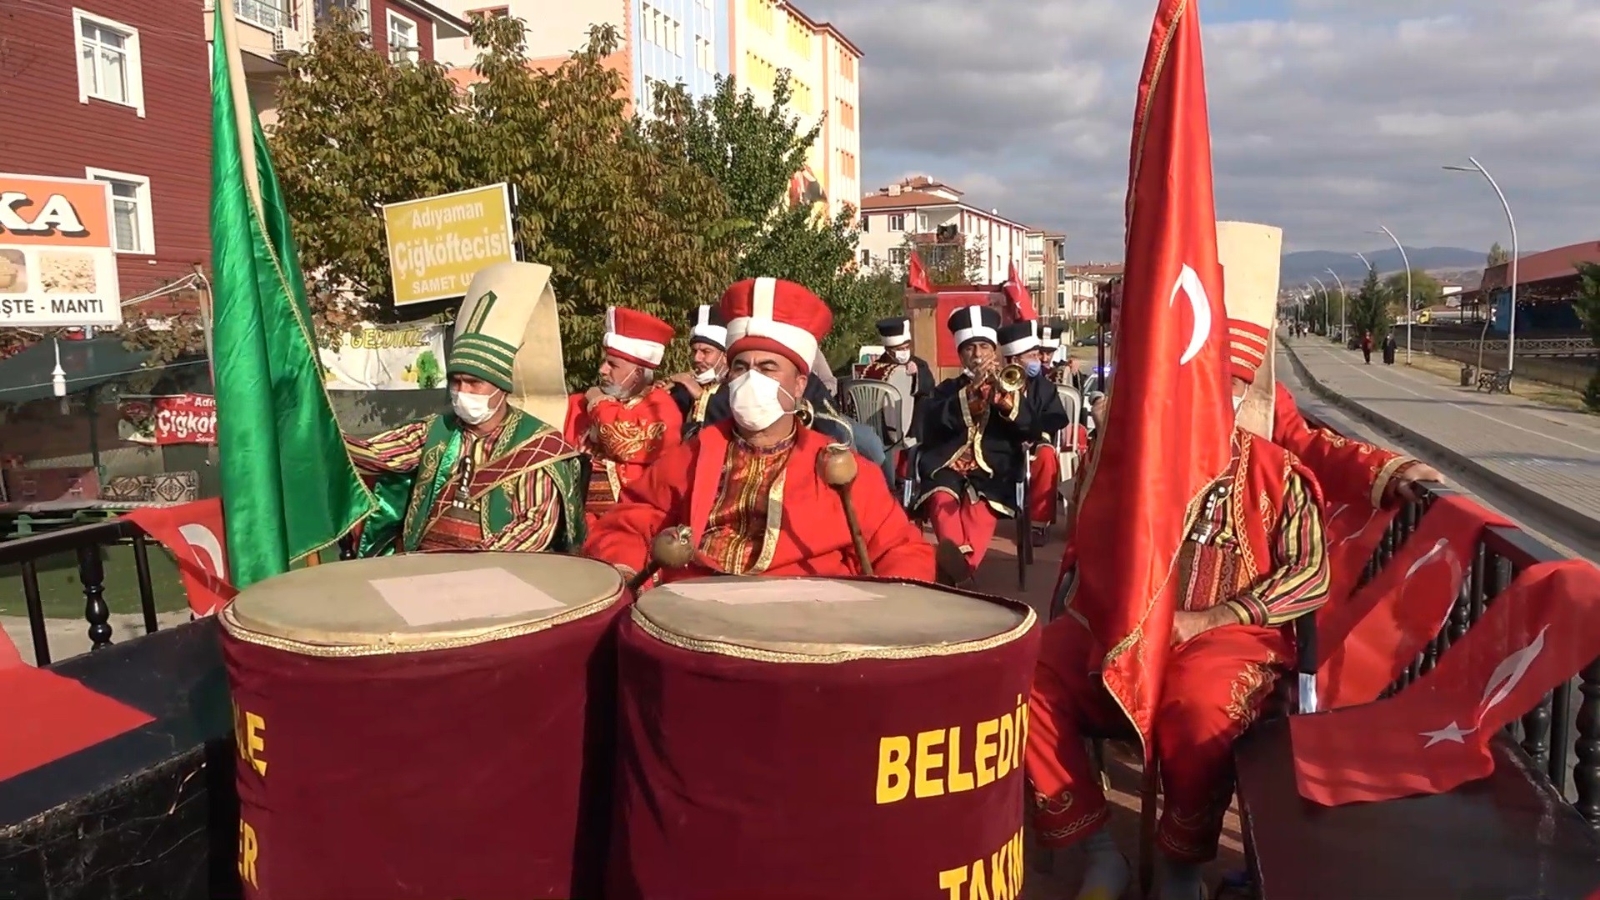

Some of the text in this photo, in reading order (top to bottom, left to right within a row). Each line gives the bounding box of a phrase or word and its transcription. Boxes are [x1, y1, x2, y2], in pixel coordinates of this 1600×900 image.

[412, 202, 484, 230] Adıyaman
[394, 225, 508, 280] Çiğköftecisi
[412, 275, 456, 294] SAMET
[0, 299, 35, 318] ŞTE
[51, 299, 103, 314] MANTI
